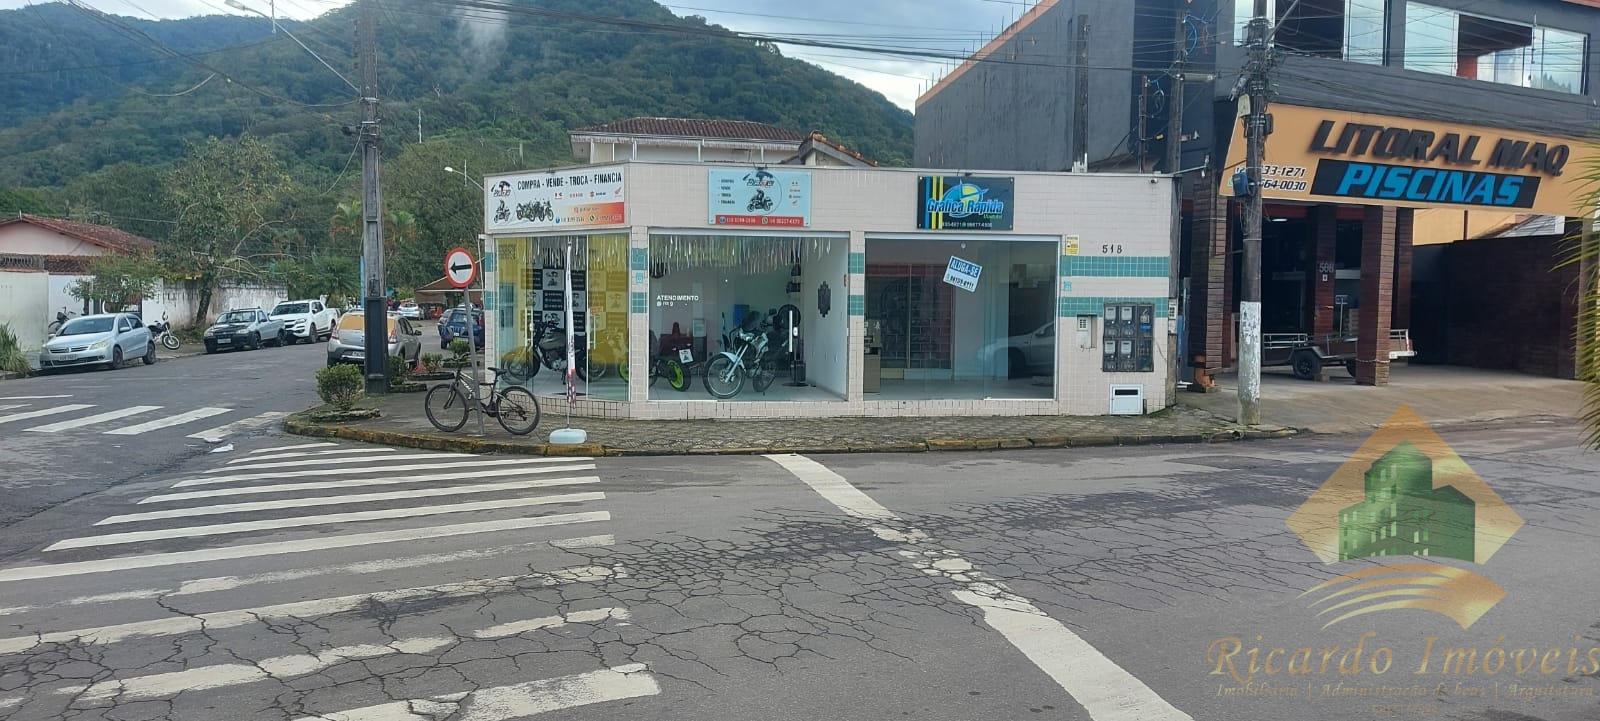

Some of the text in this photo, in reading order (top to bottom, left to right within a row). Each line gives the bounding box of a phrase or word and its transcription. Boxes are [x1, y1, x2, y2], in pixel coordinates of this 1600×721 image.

[1309, 119, 1570, 177] LITORAL MAQ
[1261, 165, 1306, 177] 33-1271
[517, 172, 622, 190] COMPRA VENDE TROCA FINANCIA
[1336, 162, 1524, 206] PISCINAS
[1102, 244, 1123, 254] 518
[950, 259, 980, 278] ALUGA-SE
